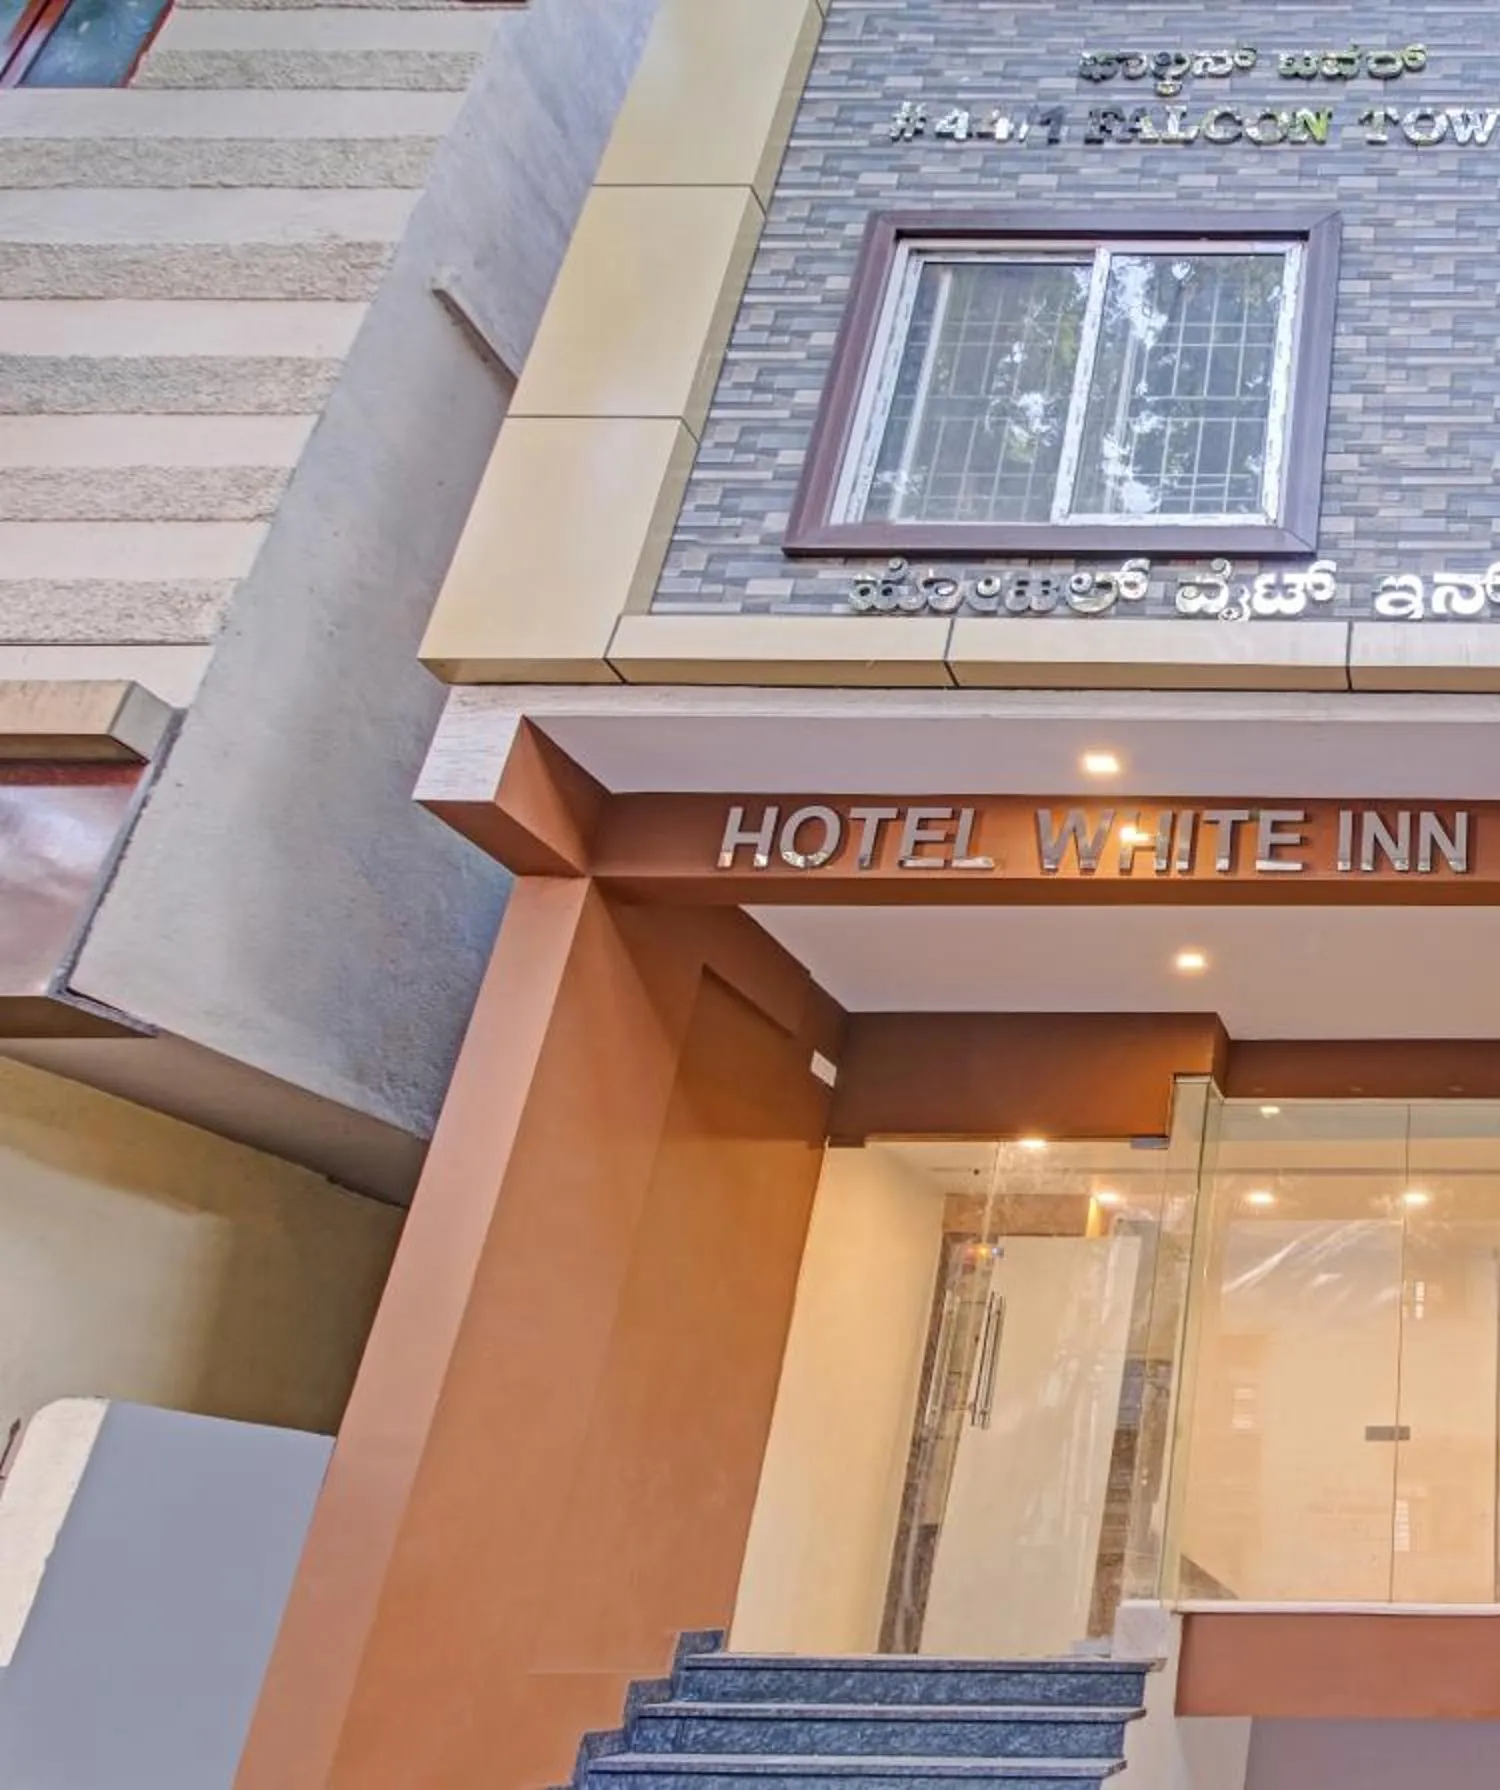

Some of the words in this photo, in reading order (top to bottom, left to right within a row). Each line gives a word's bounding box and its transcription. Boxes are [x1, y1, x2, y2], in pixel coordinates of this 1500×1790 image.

[1085, 104, 1334, 145] FALCON
[717, 805, 995, 869] HOTEL
[1035, 807, 1307, 873] WHITE
[1336, 808, 1470, 874] INN
